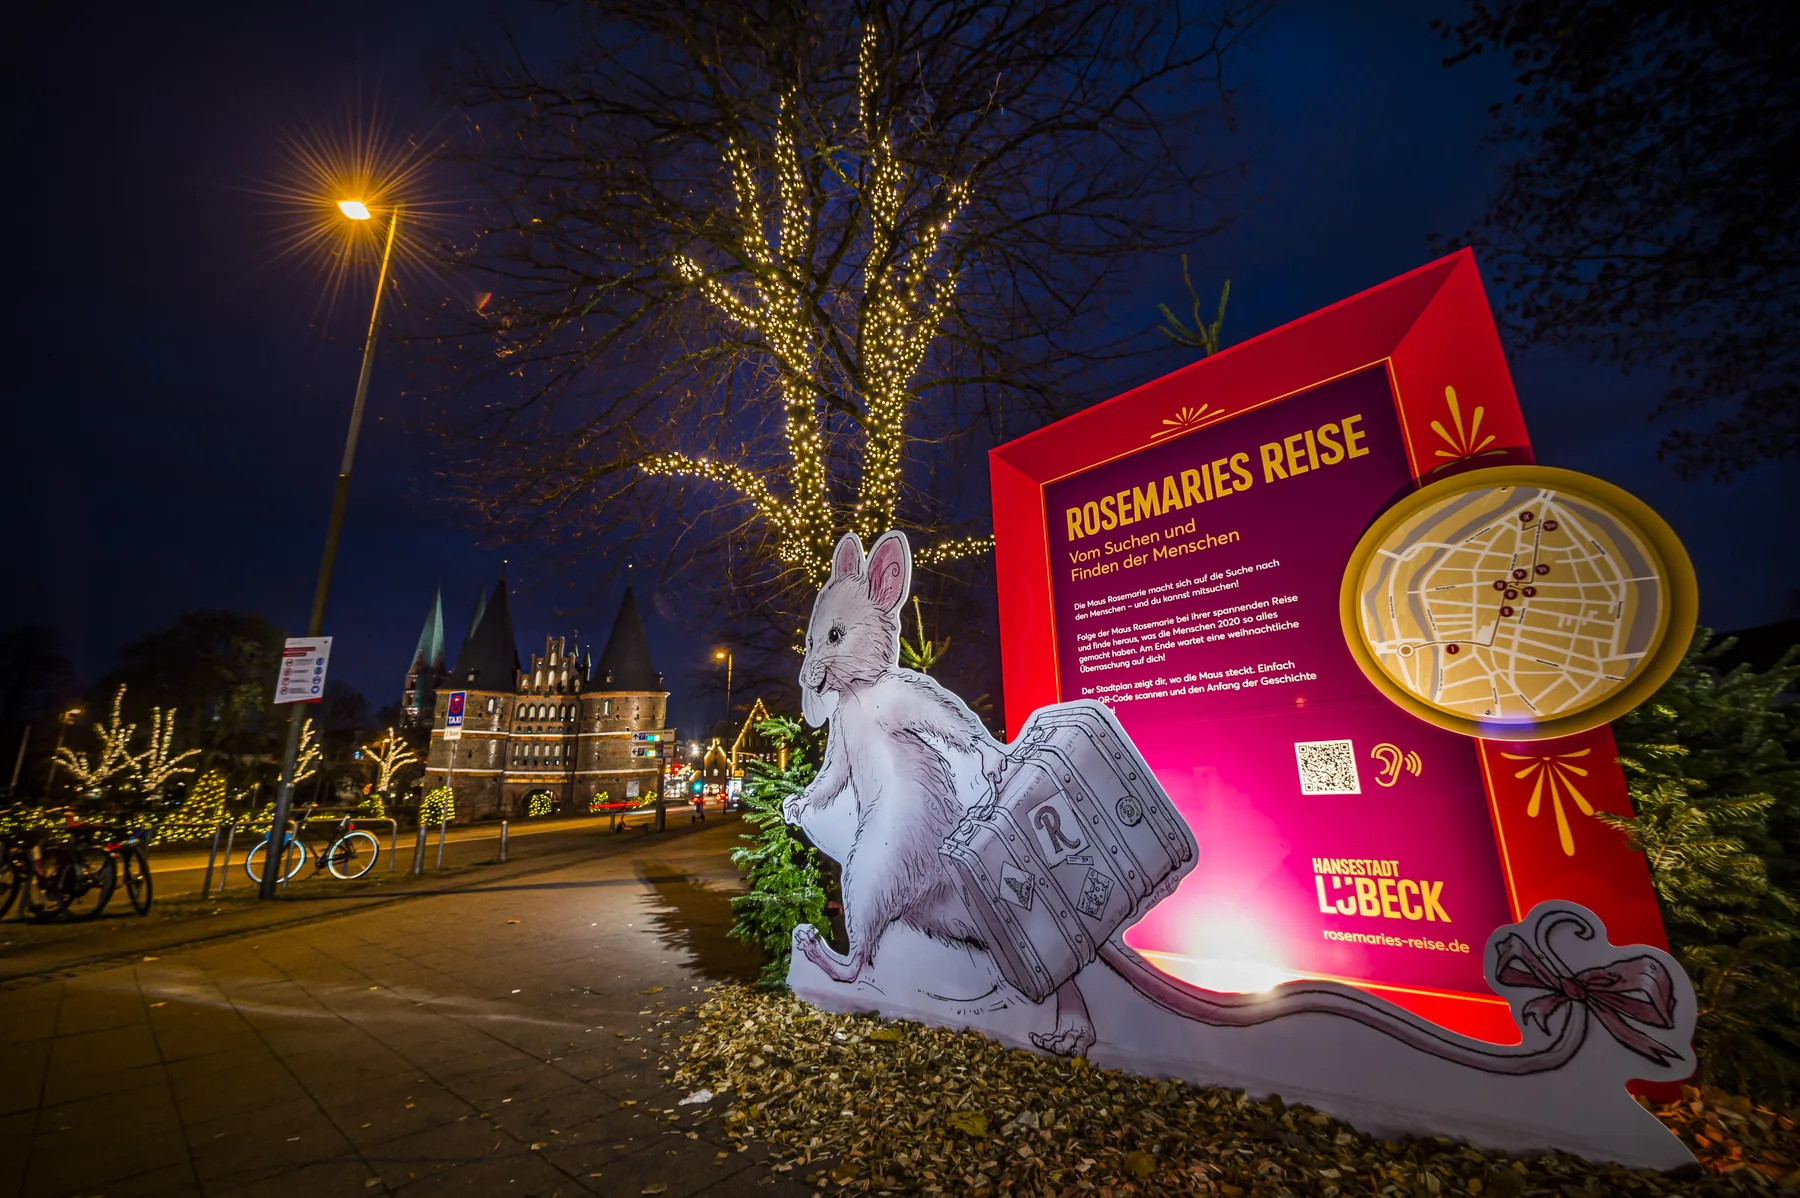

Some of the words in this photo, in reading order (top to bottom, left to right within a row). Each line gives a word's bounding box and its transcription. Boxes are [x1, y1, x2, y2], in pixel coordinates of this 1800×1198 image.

[1066, 452, 1253, 541] ROSEMARIES
[1260, 413, 1370, 484] REISE
[1069, 548, 1101, 564] Vom
[1104, 532, 1160, 555] Suchen
[1164, 518, 1196, 539] und
[1071, 561, 1119, 582] Finden
[1123, 553, 1149, 569] der
[1153, 530, 1240, 562] Menschen
[1075, 613, 1089, 621] den
[1090, 605, 1126, 617] Menschen
[1134, 599, 1149, 608] und
[1151, 597, 1161, 605] du
[1163, 591, 1190, 602] kannst
[1192, 579, 1239, 596] mitsuchen!
[1087, 599, 1106, 607] Maus
[1107, 589, 1147, 603] Rosemarie
[1148, 583, 1174, 594] macht
[1175, 579, 1192, 589] sich
[1194, 574, 1208, 584] auf
[1209, 572, 1224, 581] die
[1225, 565, 1254, 578] Suche
[1256, 559, 1280, 571] nach
[1077, 633, 1096, 641] Folge
[1111, 626, 1131, 635] Maus
[1133, 618, 1174, 631] Rosemarie
[1176, 614, 1189, 623] bei
[1191, 611, 1211, 620] ihrer
[1213, 600, 1270, 618] spannenden
[1271, 595, 1298, 606] Reise
[1078, 643, 1091, 652] und
[1092, 640, 1111, 649] finde
[1113, 637, 1139, 646] heraus,
[1141, 633, 1157, 641] was
[1158, 630, 1171, 638] die
[1173, 623, 1216, 635] Menschen
[1217, 617, 1240, 628] 2020
[1243, 616, 1253, 624] so
[1256, 612, 1278, 622] alles
[1079, 652, 1110, 664] gemacht
[1112, 648, 1138, 657] haben.
[1140, 645, 1153, 653] Am
[1154, 641, 1175, 650] Ende
[1177, 636, 1205, 647] wartet
[1206, 633, 1225, 642] eine
[1227, 620, 1299, 639] weihnachtliche
[1080, 660, 1130, 673] Überraschung
[1132, 656, 1144, 665] auf
[1146, 653, 1165, 663] dich!
[1082, 687, 1094, 695] Der
[1096, 682, 1132, 692] Stadtplan
[1134, 679, 1153, 689] zeigt
[1155, 677, 1167, 686] dir,
[1169, 676, 1181, 684] wo
[1184, 674, 1197, 682] die
[1199, 671, 1223, 680] Maus
[1225, 666, 1256, 677] steckt.
[1257, 660, 1295, 673] Einfach
[1098, 693, 1133, 703] QR-Code
[1134, 690, 1168, 700] scannen
[1170, 686, 1186, 696] und
[1188, 685, 1205, 693] den
[1206, 681, 1240, 692] Anfang
[1242, 679, 1258, 688] der
[1260, 672, 1317, 685] Geschichte
[448, 716, 462, 724] TAXI
[1034, 806, 1081, 854] R
[1312, 857, 1399, 877] HANSESTADT
[1315, 875, 1452, 922] LÜBECK
[1323, 929, 1470, 954] rosemaries-reise.de
